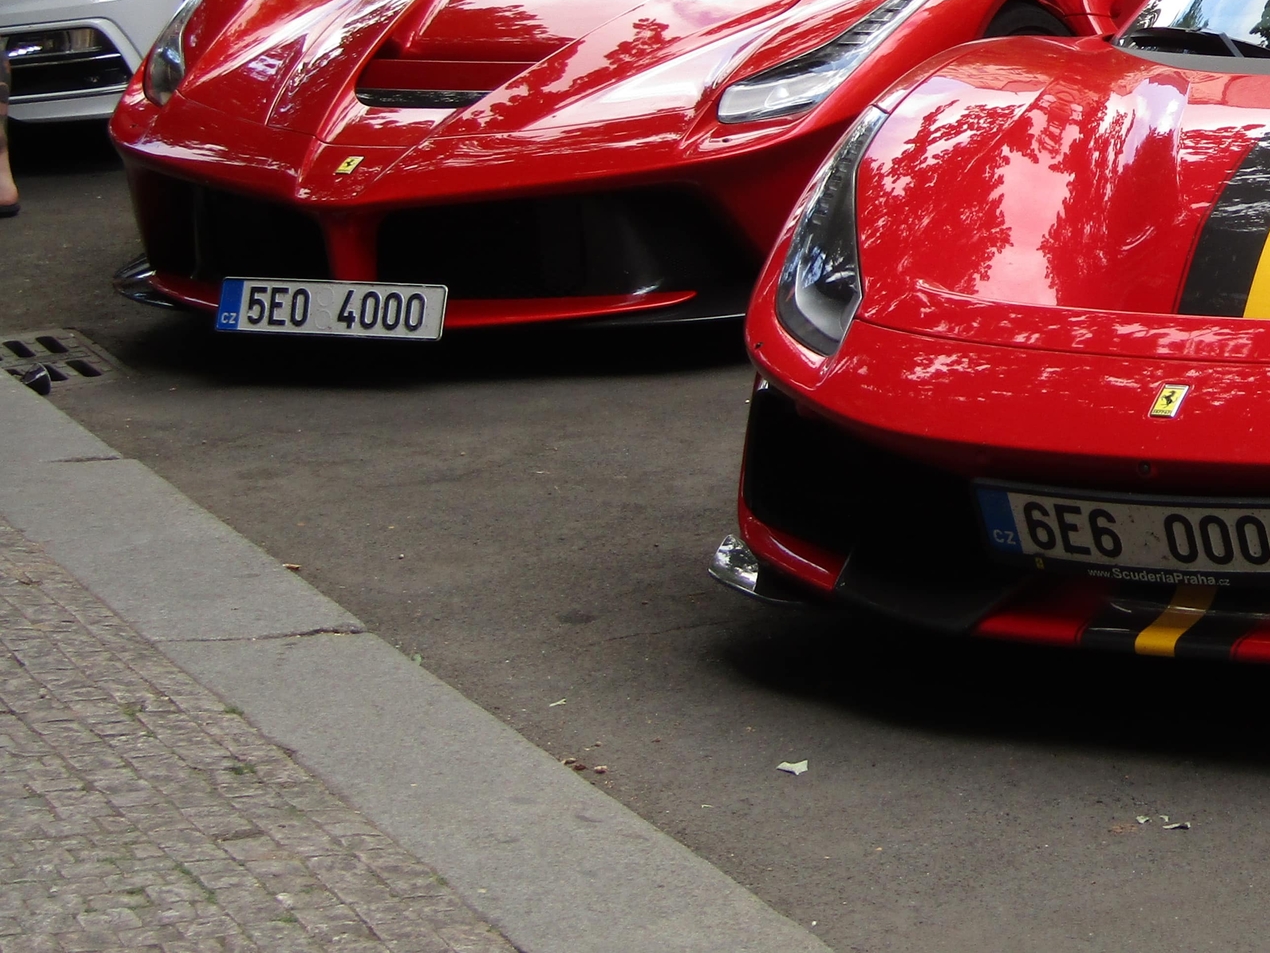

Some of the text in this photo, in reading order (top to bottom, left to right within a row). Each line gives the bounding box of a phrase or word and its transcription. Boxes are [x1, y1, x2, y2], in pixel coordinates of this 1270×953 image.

[221, 286, 427, 331] CZ 5E0 4000
[993, 528, 1017, 545] CZ
[1023, 501, 1123, 559] 6E6
[1087, 567, 1231, 586] www.ScuderiaPraha.cz
